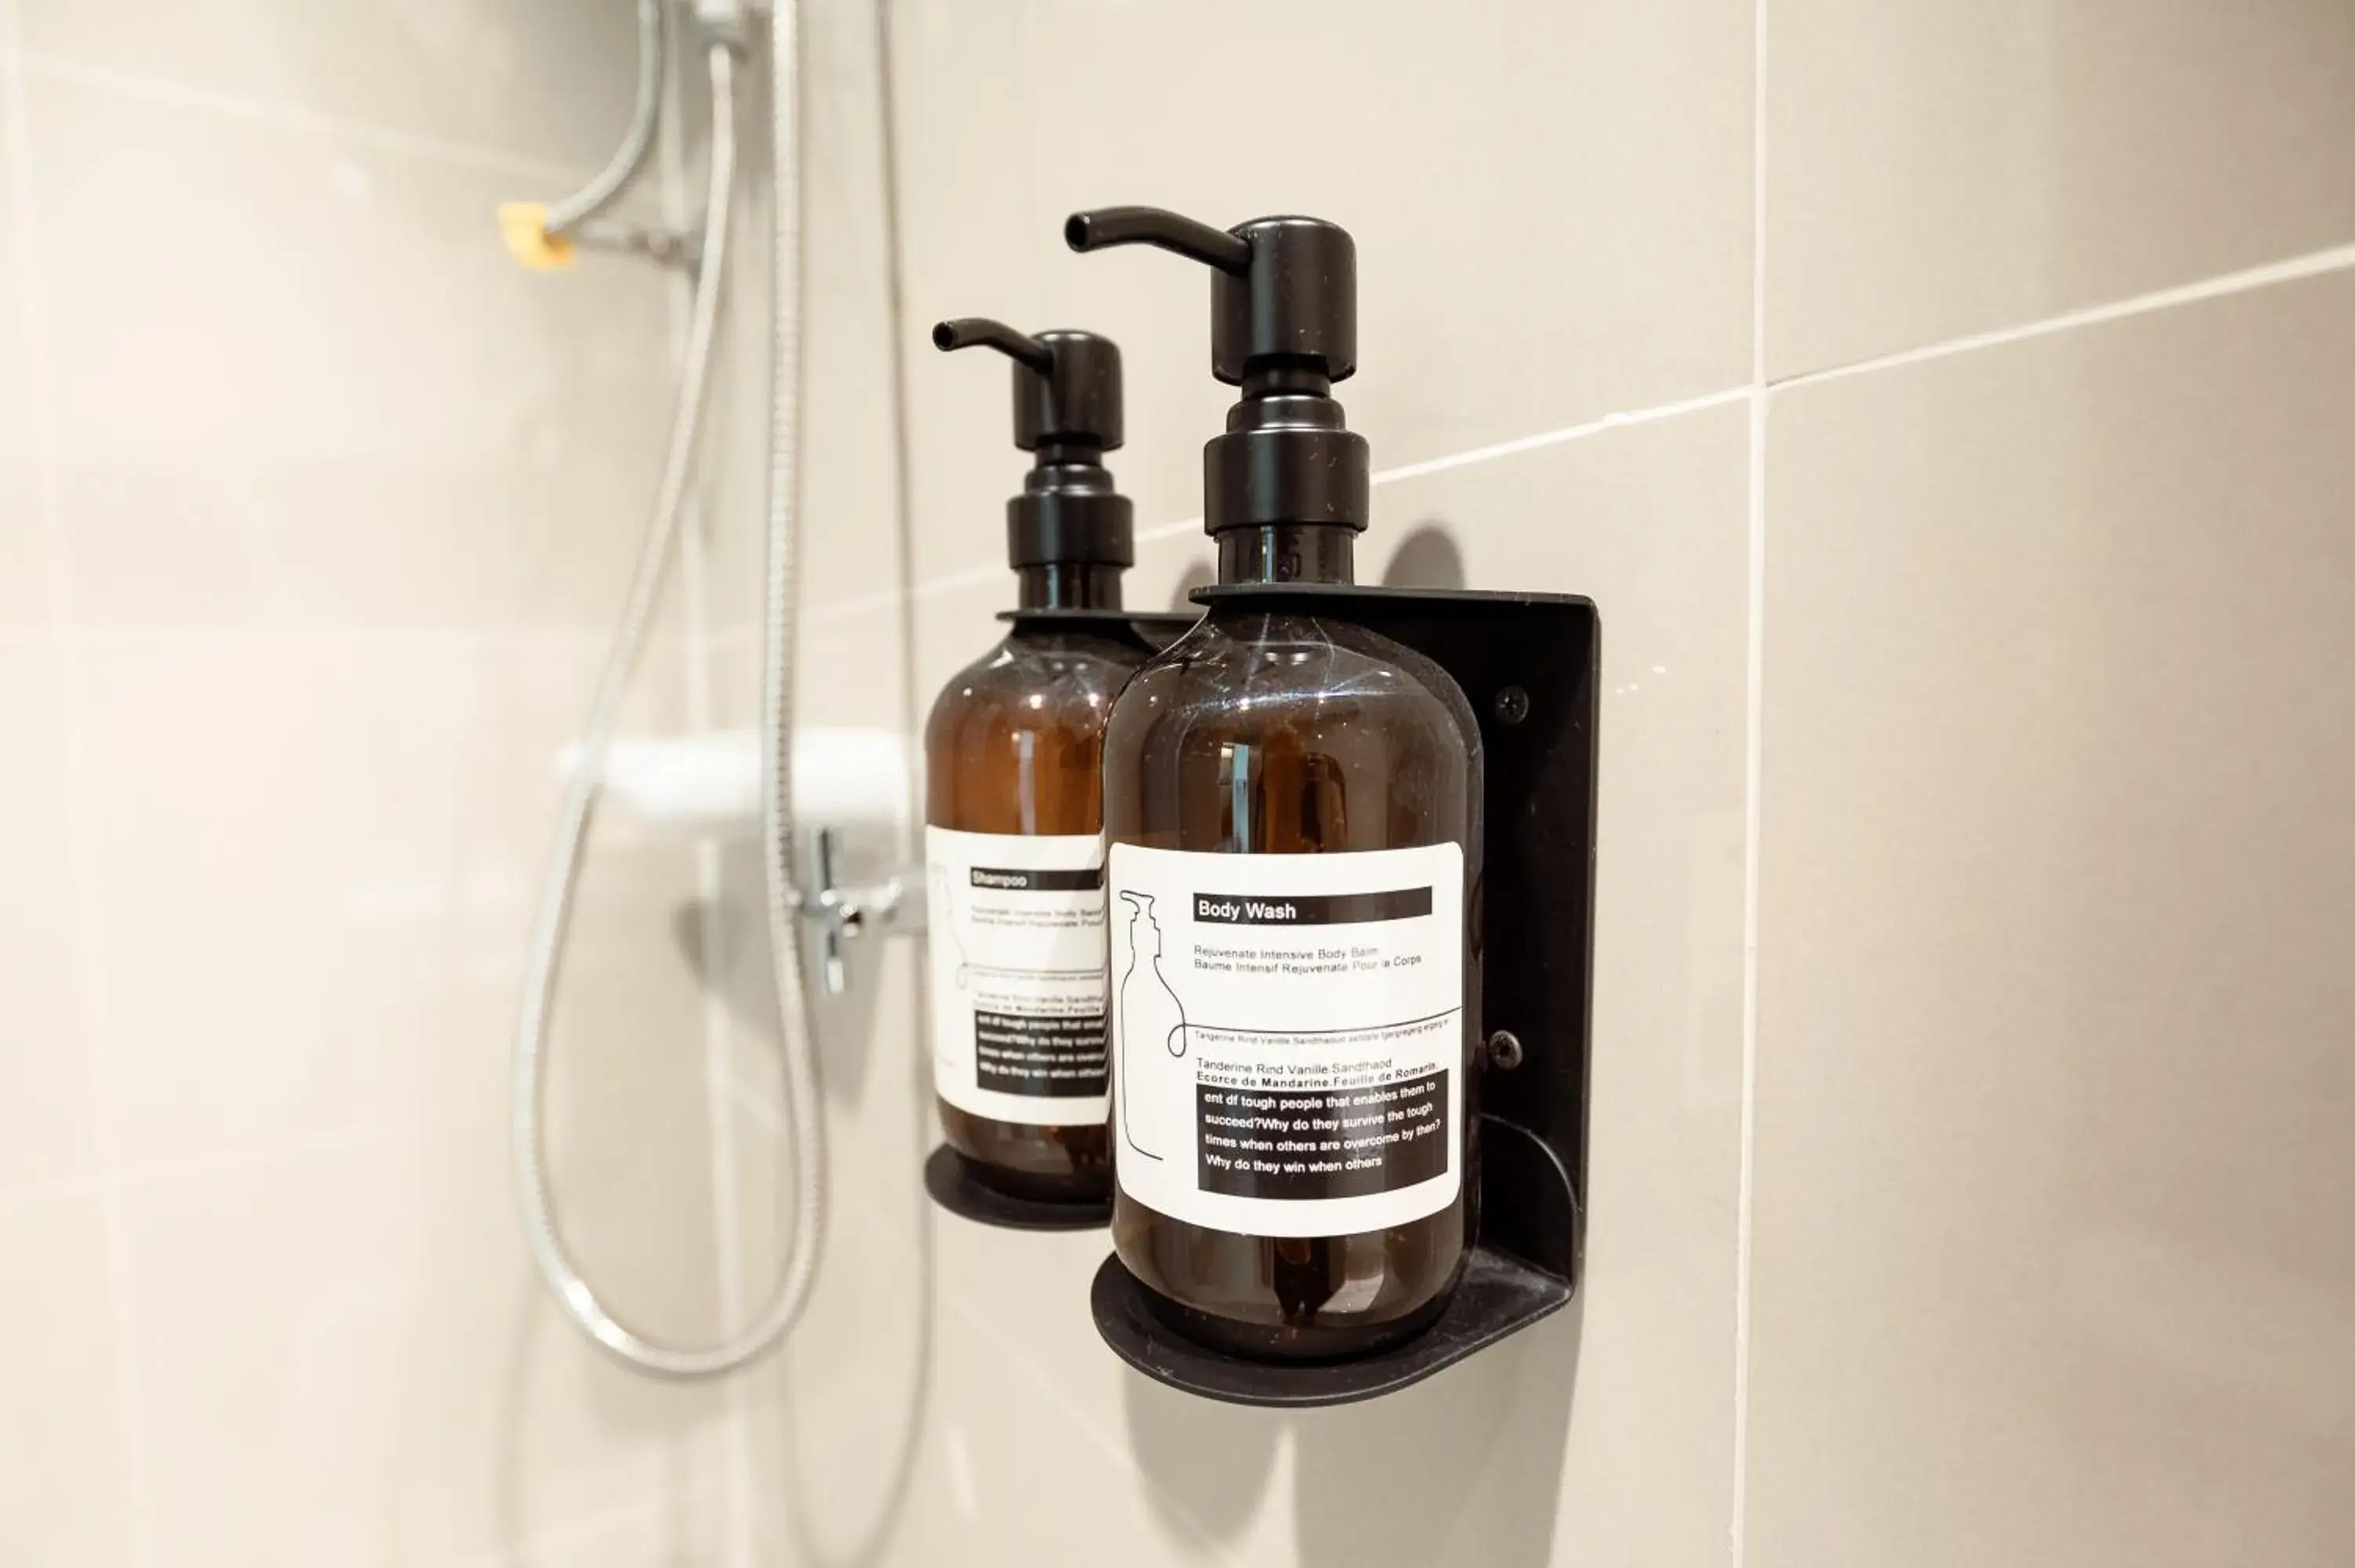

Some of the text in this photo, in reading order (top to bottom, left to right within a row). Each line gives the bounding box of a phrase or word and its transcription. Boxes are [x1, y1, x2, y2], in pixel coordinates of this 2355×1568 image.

[972, 870, 1028, 888] Shampoo
[1199, 900, 1296, 921] Body Wash
[1194, 944, 1256, 959] Rejuvenate
[1260, 949, 1314, 960] Intensive
[1318, 948, 1346, 960] Body
[1194, 958, 1232, 972] Baume
[1236, 962, 1278, 973] Intensif
[1282, 963, 1348, 975] Rejuvenate
[1393, 954, 1422, 966] Corps
[1197, 1071, 1237, 1085] Ecorce
[1241, 1077, 1256, 1087] de
[1378, 1070, 1392, 1081] de
[1257, 1063, 1283, 1074] Rind
[1287, 1064, 1328, 1074] Vanille
[1204, 1093, 1223, 1104] ent
[1241, 1096, 1276, 1110] tough
[1280, 1096, 1323, 1110] people
[1326, 1096, 1350, 1108] that
[1353, 1090, 1398, 1105] enables
[1400, 1085, 1425, 1099] them
[1426, 1081, 1436, 1091] to
[1292, 1118, 1309, 1131] do
[1312, 1118, 1339, 1132] they
[1342, 1113, 1386, 1129] survive
[1387, 1110, 1404, 1121] the
[1406, 1102, 1433, 1118] tough
[1205, 1132, 1236, 1148] times
[1240, 1138, 1273, 1150] when
[1276, 1140, 1316, 1151] others
[1320, 1140, 1340, 1151] are
[1344, 1132, 1400, 1150] overcome
[1401, 1129, 1415, 1142] by
[1205, 1153, 1382, 1175] Why do they win when others
